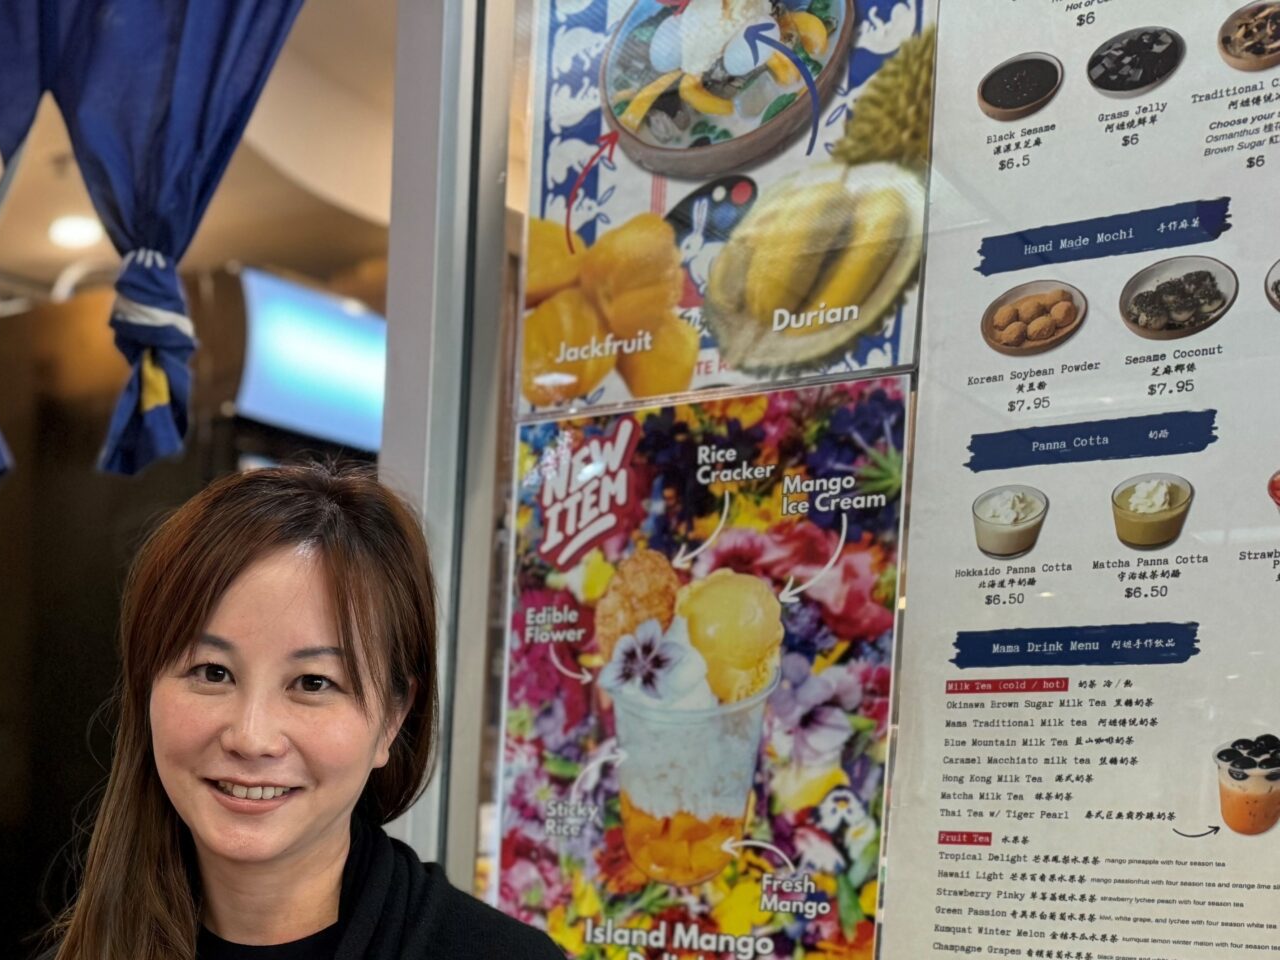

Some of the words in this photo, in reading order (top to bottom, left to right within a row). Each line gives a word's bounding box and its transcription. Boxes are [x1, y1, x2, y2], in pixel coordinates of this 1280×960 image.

[1076, 12, 1095, 26] $6
[1192, 81, 1264, 103] Traditional
[1098, 109, 1129, 122] Grass
[1135, 101, 1167, 115] Jelly
[1209, 117, 1248, 130] Choose
[1250, 111, 1276, 124] your
[986, 130, 1015, 144] Black
[1020, 123, 1056, 137] Sesame
[1122, 133, 1140, 147] $6
[1206, 127, 1260, 143] Osmanthus
[1204, 144, 1234, 156] Brown
[1236, 139, 1266, 150] Sugar
[998, 155, 1030, 171] $6.5
[1246, 154, 1265, 168] $6
[1024, 241, 1053, 255] Hand
[1060, 236, 1089, 249] Made
[1096, 228, 1135, 243] Mochi
[772, 304, 860, 332] Durian
[555, 330, 652, 364] Jackfruit
[1124, 352, 1167, 365] Sesame
[1173, 344, 1224, 359] Coconut
[968, 374, 1004, 386] Korean
[1010, 367, 1054, 381] Soybean
[1061, 361, 1101, 374] Powder
[1147, 379, 1194, 396] $7.95
[1008, 396, 1050, 412] $7.95
[1032, 441, 1066, 451] Panna
[1073, 435, 1109, 447] Cotta
[543, 418, 633, 505] NEW
[697, 445, 737, 464] Rice
[696, 463, 775, 486] Cracker
[782, 474, 856, 501] Mango
[540, 469, 626, 554] ITEM
[782, 496, 810, 515] Ice
[815, 492, 886, 512] Cream
[955, 566, 1000, 578] Hokkaido
[1006, 566, 1036, 574] Panna
[1042, 562, 1072, 572] Cotta
[1092, 560, 1130, 570] Matcha
[1136, 557, 1169, 567] Panna
[1176, 554, 1208, 565] Cotta
[985, 593, 1024, 605] $6.50
[1124, 585, 1168, 598] $6.50
[525, 606, 579, 626] Edible
[525, 622, 585, 644] Flower
[992, 644, 1020, 653] Mama
[1027, 642, 1063, 652] Drink
[1070, 640, 1099, 650] Menu
[948, 682, 969, 690] Milk
[976, 682, 992, 690] Tea
[998, 680, 1026, 690] (cold
[1043, 680, 1066, 689] hot)
[946, 700, 985, 709] Okinawa
[990, 700, 1019, 708] Brown
[1024, 700, 1054, 710] Sugar
[1059, 699, 1083, 707] Milk
[1088, 699, 1107, 707] Tea
[945, 720, 967, 728] Mama
[973, 719, 1034, 727] Traditional
[1040, 719, 1064, 727] Milk
[1070, 719, 1087, 727] tea
[944, 738, 966, 747] Blue
[972, 738, 1016, 747] Mountain
[1022, 738, 1046, 746] Milk
[1051, 738, 1068, 746] Tea
[943, 756, 981, 765] Caramel
[987, 756, 1038, 765] Macchiato
[1044, 756, 1067, 764] milk
[942, 774, 964, 784] Hong
[970, 774, 992, 784] Kong
[997, 774, 1020, 783] Milk
[1025, 774, 1043, 783] Tea
[941, 792, 973, 800] Matcha
[979, 792, 1001, 800] Milk
[1007, 792, 1024, 801] Tea
[546, 802, 599, 825] Sticky
[939, 809, 961, 817] Thai
[967, 809, 984, 817] Tea
[989, 810, 1000, 818] w/
[1006, 810, 1035, 820] Tiger
[1040, 810, 1069, 819] Pearl
[545, 818, 582, 837] Rice
[940, 833, 967, 842] Fruit
[972, 834, 990, 842] Tea
[938, 852, 982, 864] Tropical
[988, 853, 1028, 864] Delight
[762, 873, 815, 893] Fresh
[937, 870, 970, 879] Hawaii
[975, 871, 1004, 882] Light
[936, 888, 991, 900] Strawberry
[996, 890, 1025, 901] Pinky
[760, 894, 831, 919] Mango
[935, 906, 962, 915] Green
[967, 907, 1007, 917] Passion
[934, 924, 972, 934] Kumquat
[978, 926, 1011, 936] Winter
[1016, 929, 1045, 938] Melon
[586, 919, 666, 949] Island
[672, 928, 774, 960] Mango
[932, 942, 982, 954] Champagne
[987, 946, 1021, 956] Grapes
